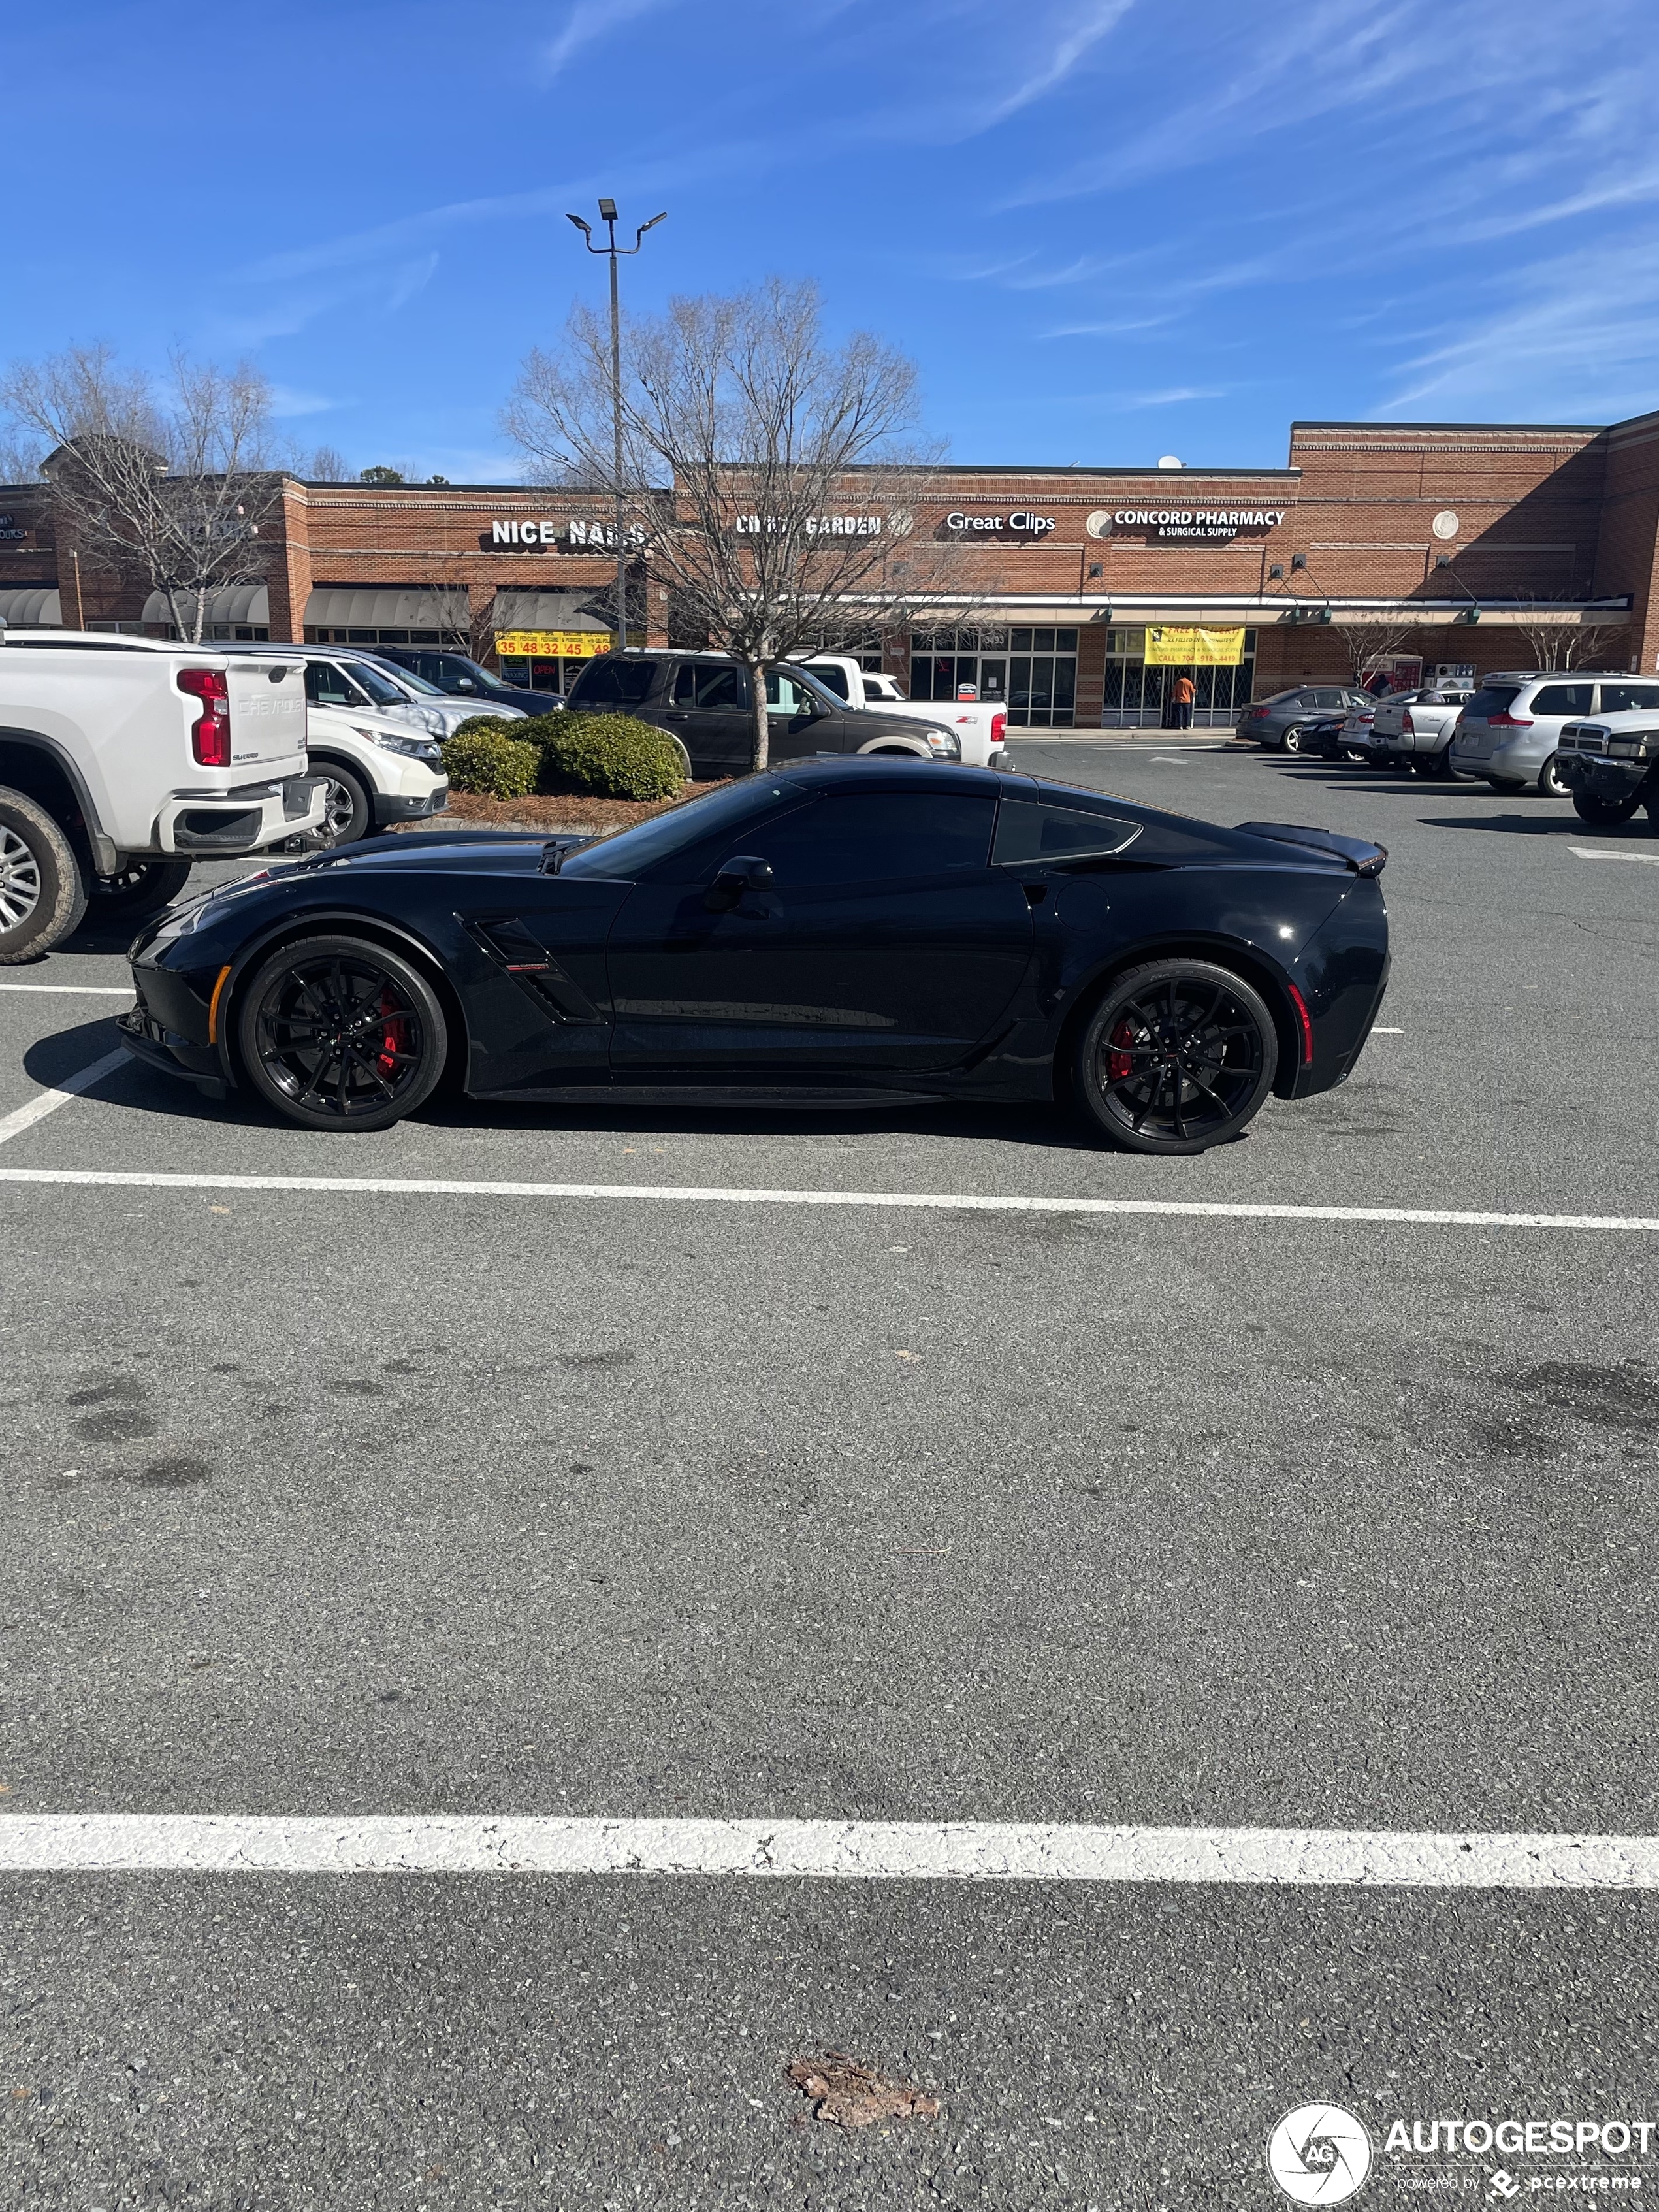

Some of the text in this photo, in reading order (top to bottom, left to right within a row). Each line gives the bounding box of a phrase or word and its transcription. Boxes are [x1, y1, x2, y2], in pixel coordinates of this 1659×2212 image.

[805, 516, 881, 534] GARDEN
[947, 512, 1055, 534] Great Clips
[1115, 511, 1285, 525] CONCORD PHARMACY
[492, 521, 555, 544] NICE
[1159, 527, 1238, 536] & SURGICAL SUPPLY
[1168, 625, 1190, 634] FREE
[533, 664, 556, 674] OPEN
